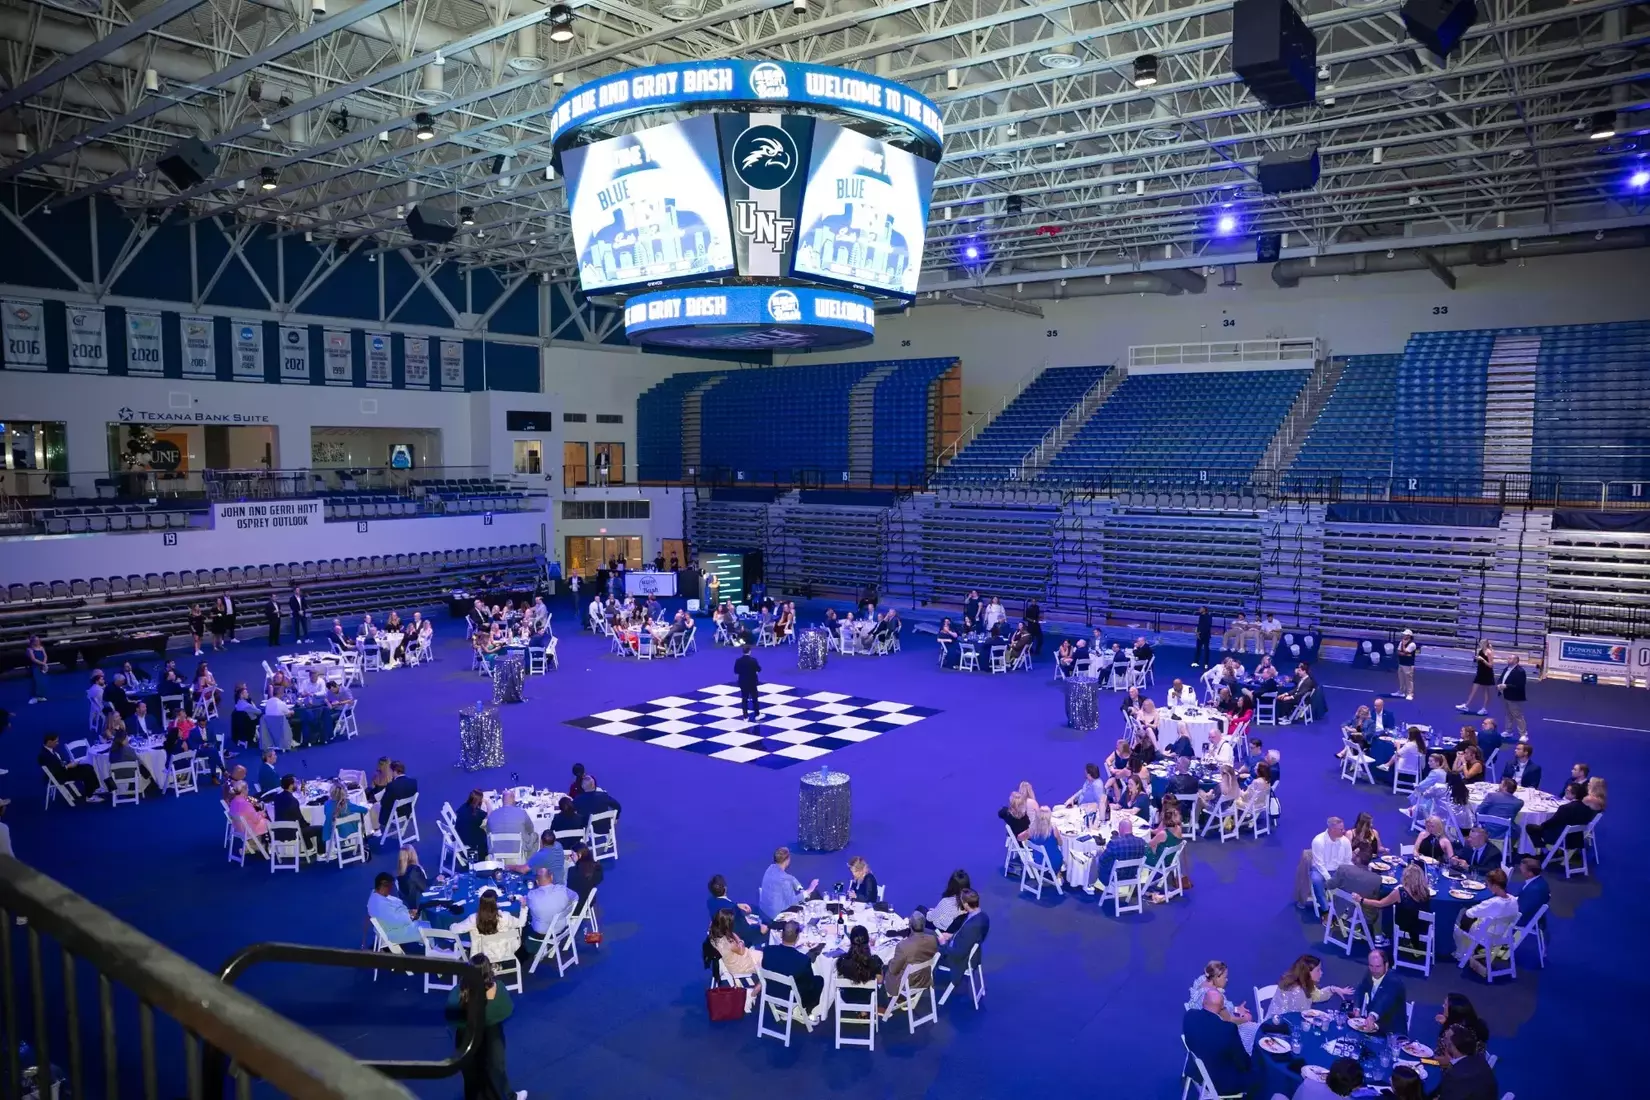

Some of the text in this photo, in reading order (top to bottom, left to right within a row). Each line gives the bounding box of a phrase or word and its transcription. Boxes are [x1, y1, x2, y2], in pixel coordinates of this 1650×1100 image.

[571, 89, 597, 119] BLUE
[599, 80, 628, 107] AND
[632, 72, 678, 99] GRAY
[683, 68, 733, 93] BASH
[805, 72, 881, 107] WELCOME
[885, 87, 901, 113] TO
[596, 179, 631, 212] BLUE
[836, 178, 865, 200] BLUE
[735, 200, 795, 254] UNF
[648, 298, 681, 320] GRAY
[685, 295, 727, 317] BASH
[815, 298, 865, 323] WELCOME
[1432, 306, 1448, 315] 33
[1223, 319, 1235, 327] 34
[1046, 330, 1058, 338] 35
[9, 339, 40, 355] 2016
[72, 343, 102, 359] 2020
[131, 347, 159, 362] 2020
[285, 357, 305, 371] 2021
[138, 411, 269, 423] TEXANA BANK SUITE
[150, 450, 179, 464] UNF
[1199, 470, 1207, 481] 13
[1408, 478, 1417, 490] 12
[1632, 483, 1642, 497] 11
[221, 503, 318, 518] JOHN AND GERRI HAYT
[237, 516, 308, 529] OSPREY OUTLOOK
[359, 522, 367, 532] 18
[484, 515, 491, 525] 17
[165, 533, 175, 545] 19
[1567, 646, 1603, 655] DONOVAN
